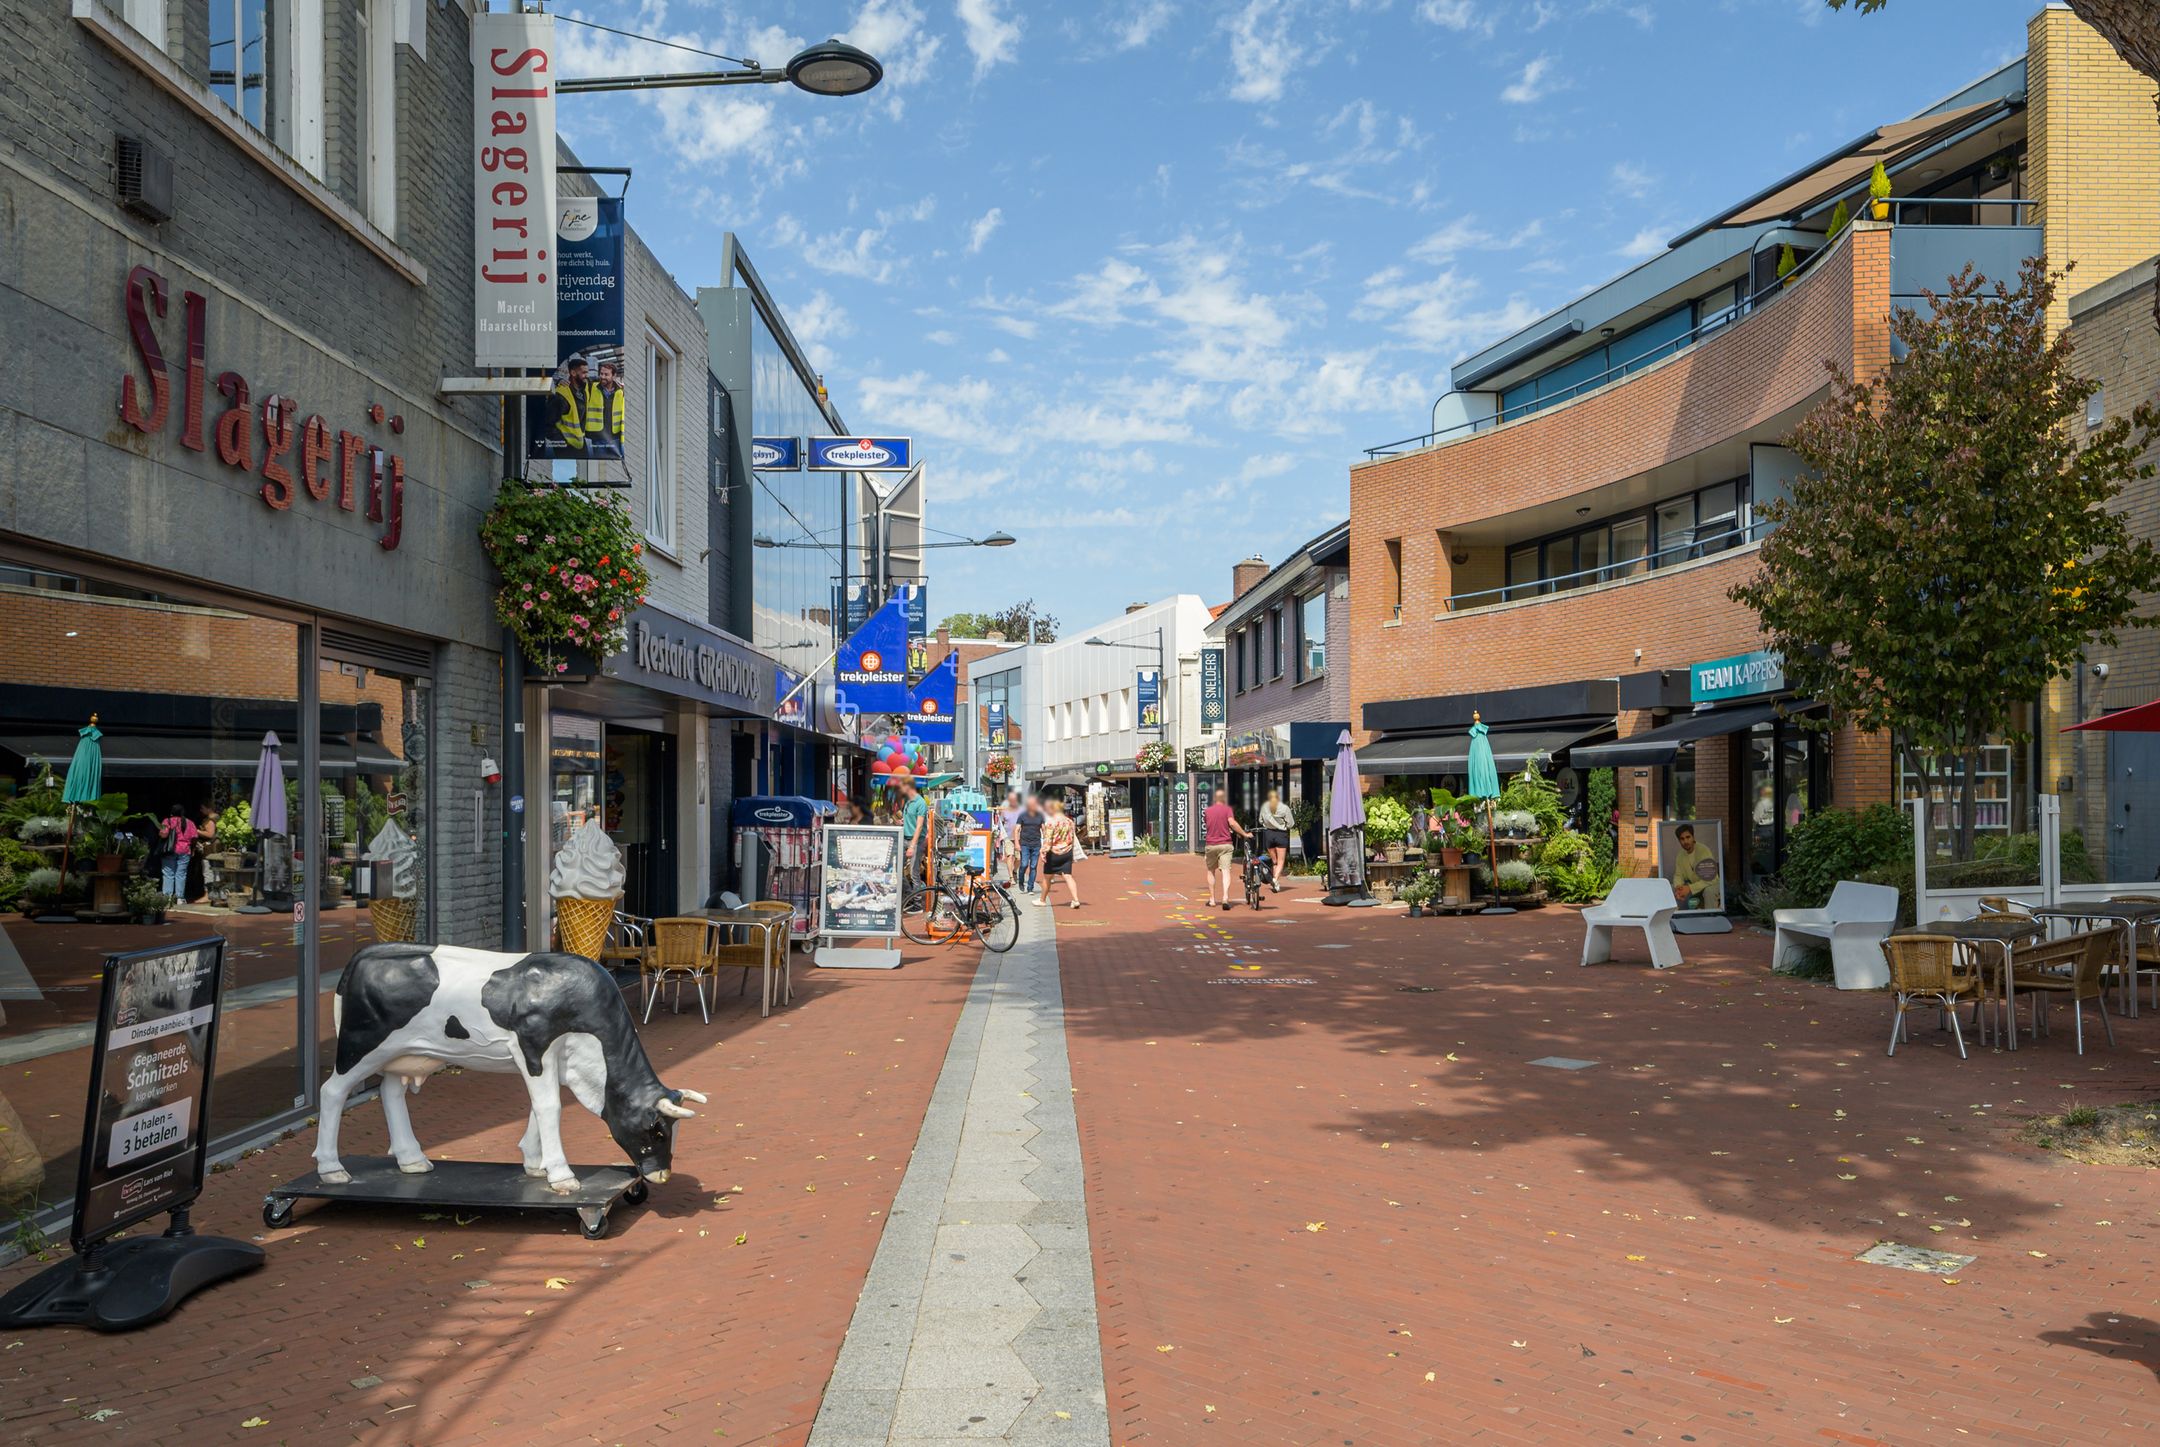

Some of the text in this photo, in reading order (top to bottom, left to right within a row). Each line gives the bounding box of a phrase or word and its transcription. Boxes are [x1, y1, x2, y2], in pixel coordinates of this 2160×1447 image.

[481, 48, 548, 283] Slagerij
[586, 259, 595, 268] bij
[557, 274, 616, 288] rijvendag
[497, 300, 535, 313] Marcel
[480, 319, 553, 332] Haarselhorst
[121, 264, 404, 550] Slagerij
[831, 450, 885, 461] trekpleister
[840, 671, 904, 683] trekpleister
[1205, 653, 1216, 699] SNELDERS
[1698, 657, 1777, 691] TEAM KAPPERS
[907, 713, 953, 723] trekpleister
[1174, 793, 1185, 841] broeders
[131, 1024, 160, 1040] Dinsdag
[134, 1042, 187, 1068] Gepaneerde
[126, 1057, 188, 1090] Schnitzels
[136, 1082, 178, 1103] kip of varken
[133, 1121, 139, 1133] 4
[141, 1113, 166, 1131] halen
[123, 1125, 178, 1155] 3 betalen
